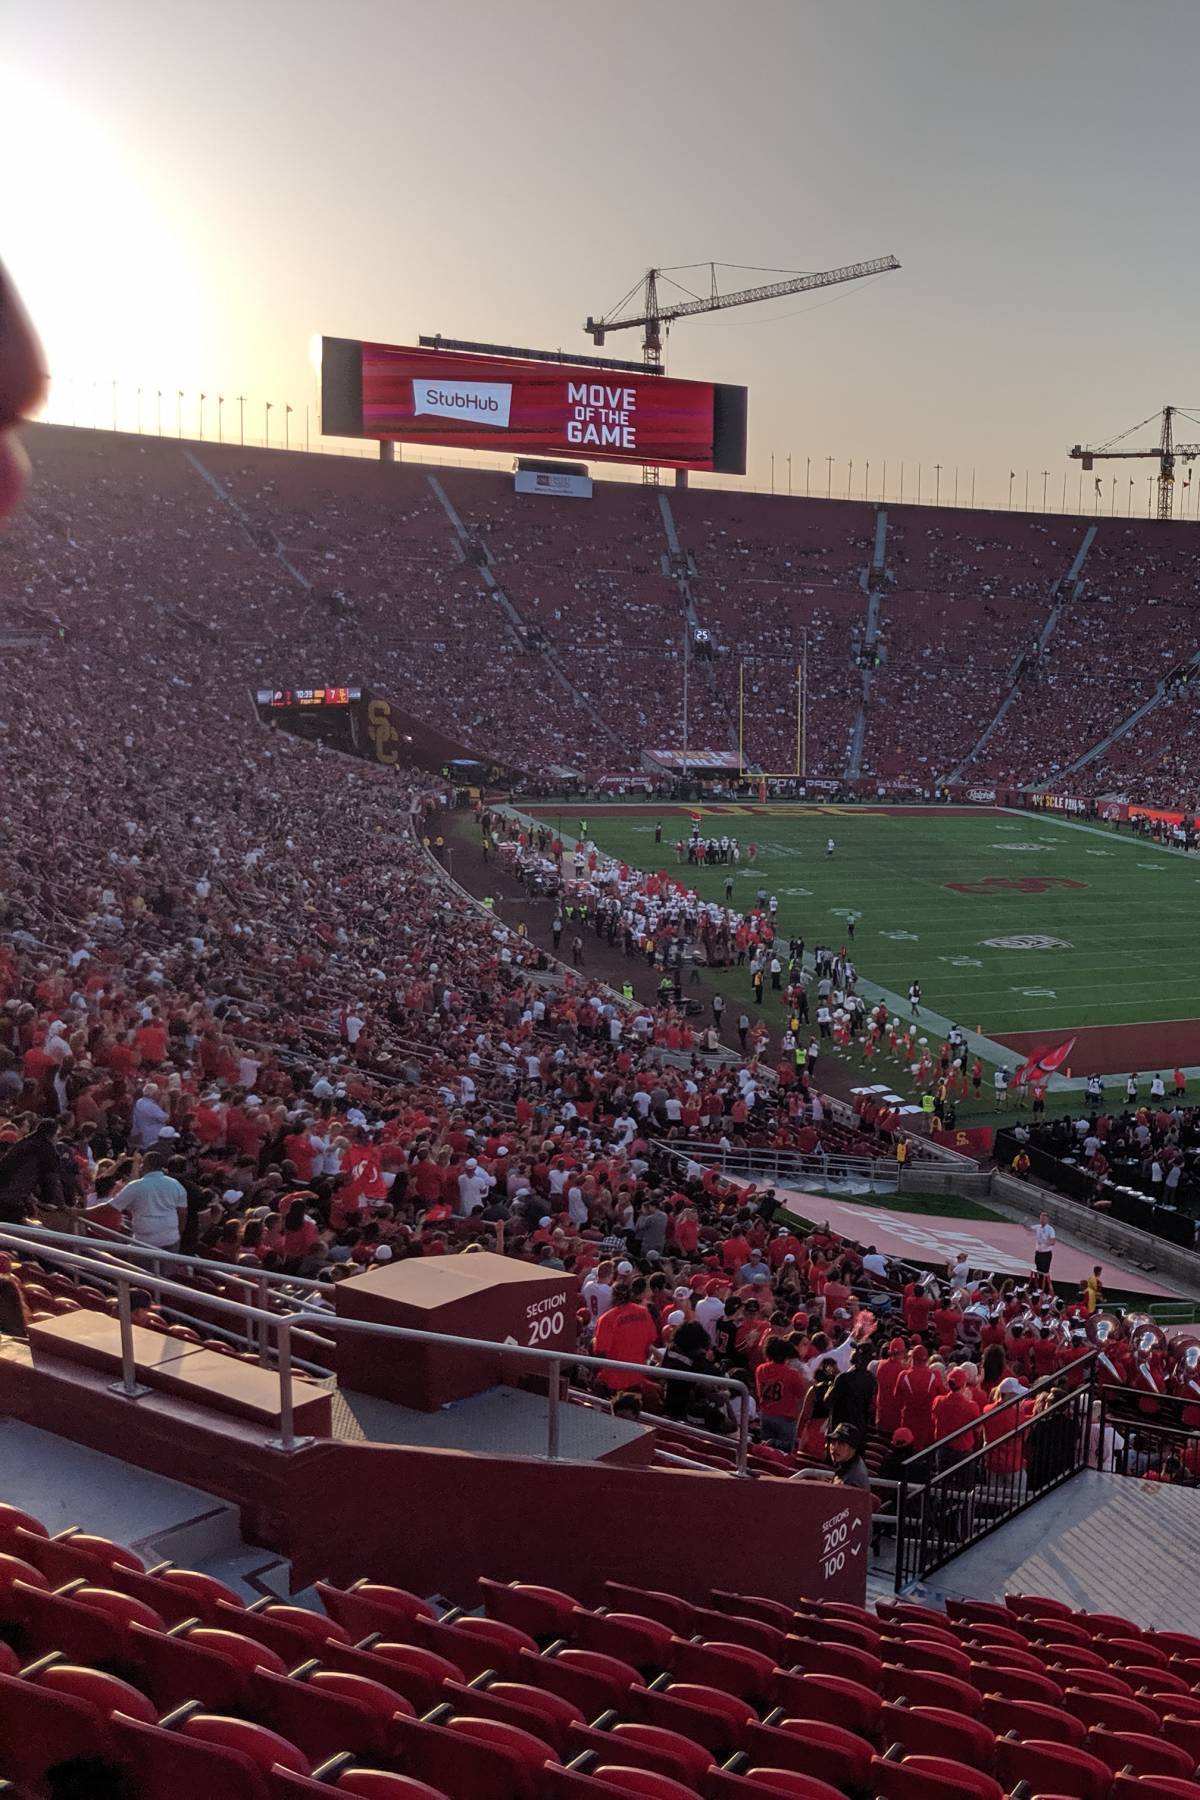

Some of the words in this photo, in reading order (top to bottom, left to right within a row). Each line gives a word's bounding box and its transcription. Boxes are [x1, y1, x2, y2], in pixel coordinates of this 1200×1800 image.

[426, 389, 499, 411] StubHub
[568, 382, 637, 410] MOVE
[575, 406, 595, 421] OF
[599, 409, 630, 425] THE
[567, 421, 636, 449] GAME
[652, 751, 737, 761] MUSCLE
[526, 1291, 567, 1318] SECTION
[528, 1311, 564, 1346] 200
[822, 1507, 850, 1532] SECTIONS
[823, 1523, 848, 1554] 200
[824, 1551, 846, 1579] 100
